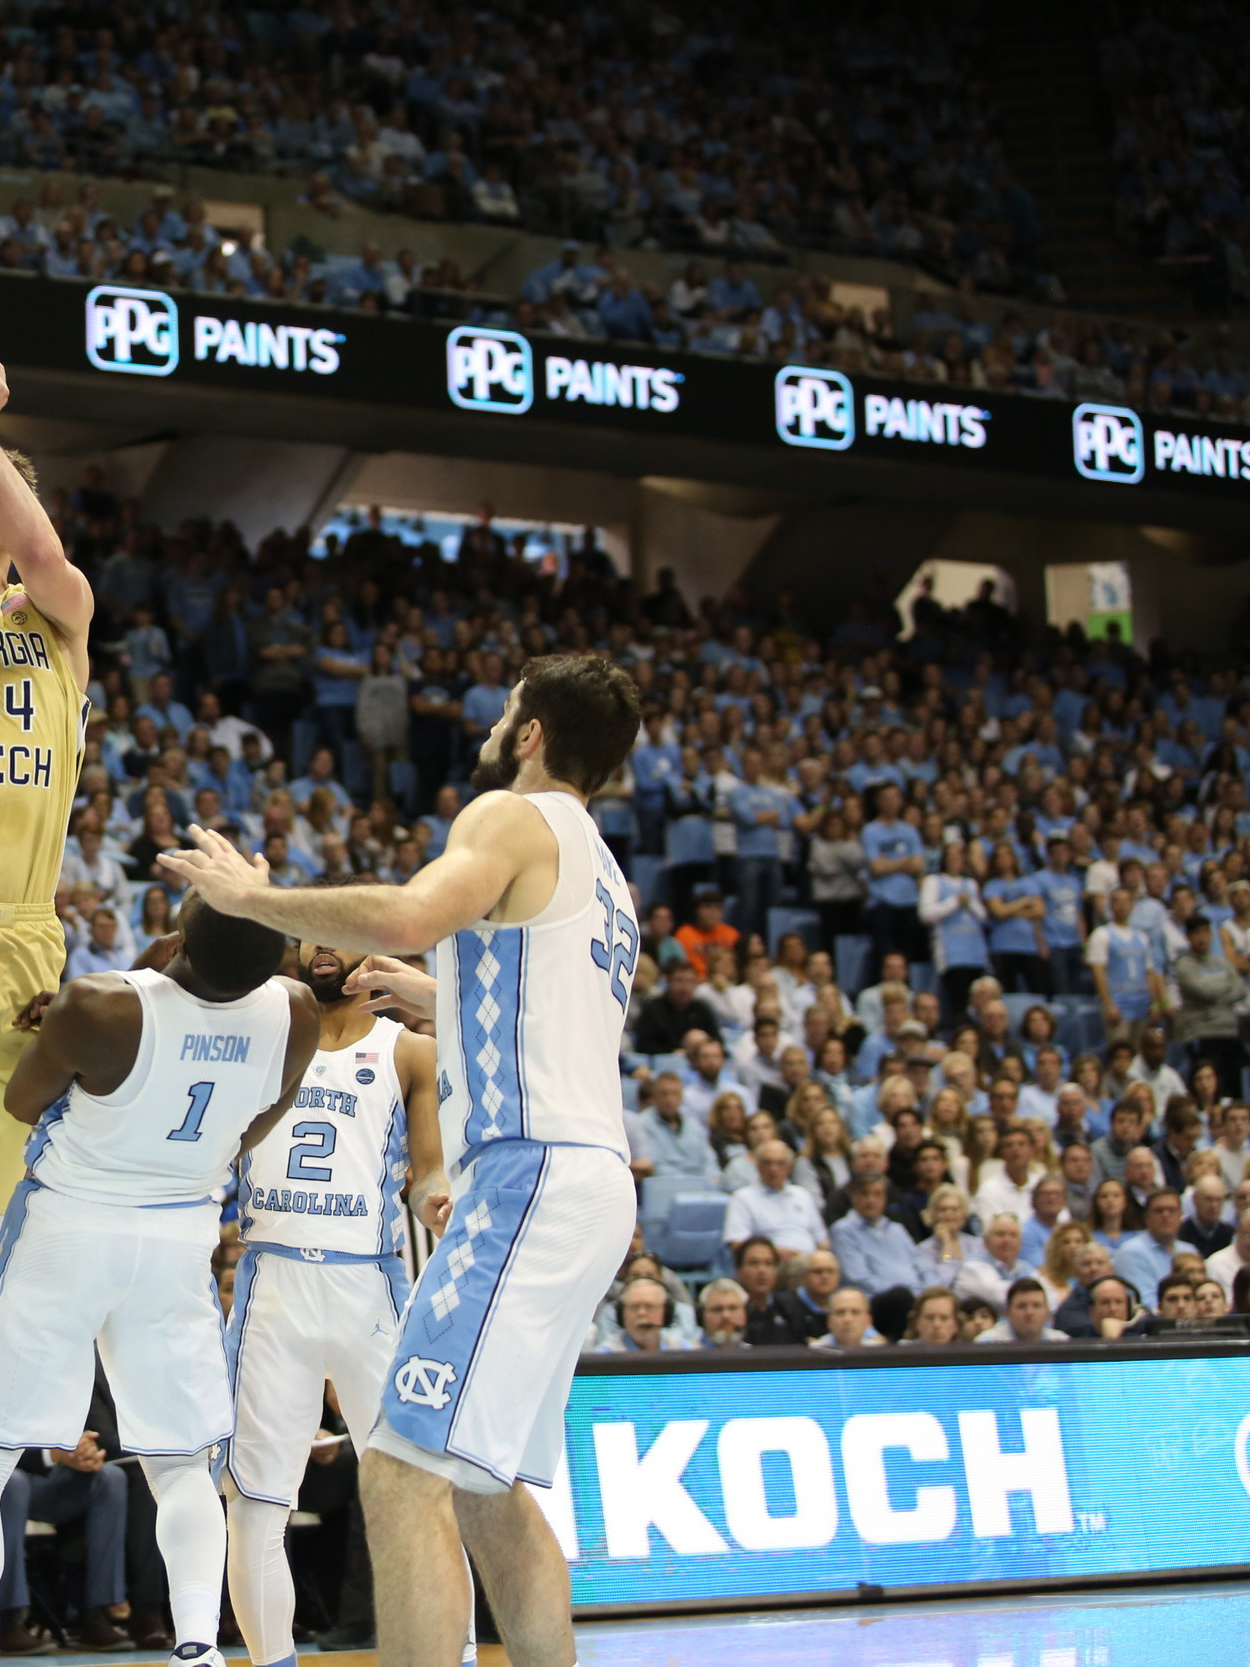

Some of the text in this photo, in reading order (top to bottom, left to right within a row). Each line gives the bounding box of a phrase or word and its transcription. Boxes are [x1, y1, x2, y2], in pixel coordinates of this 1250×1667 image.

[93, 297, 340, 375] PPG PAINTS
[455, 338, 681, 412] PPG PAINTS
[781, 377, 987, 448] PPG PAINTS
[1079, 414, 1137, 472] PPG
[591, 877, 639, 1015] 32
[180, 1034, 251, 1063] PINSON
[167, 1081, 215, 1142] 1
[293, 1086, 358, 1118] ORTH
[286, 1121, 337, 1182] 2
[252, 1188, 368, 1217] CAROLINA
[592, 1406, 1076, 1560] KOCH
